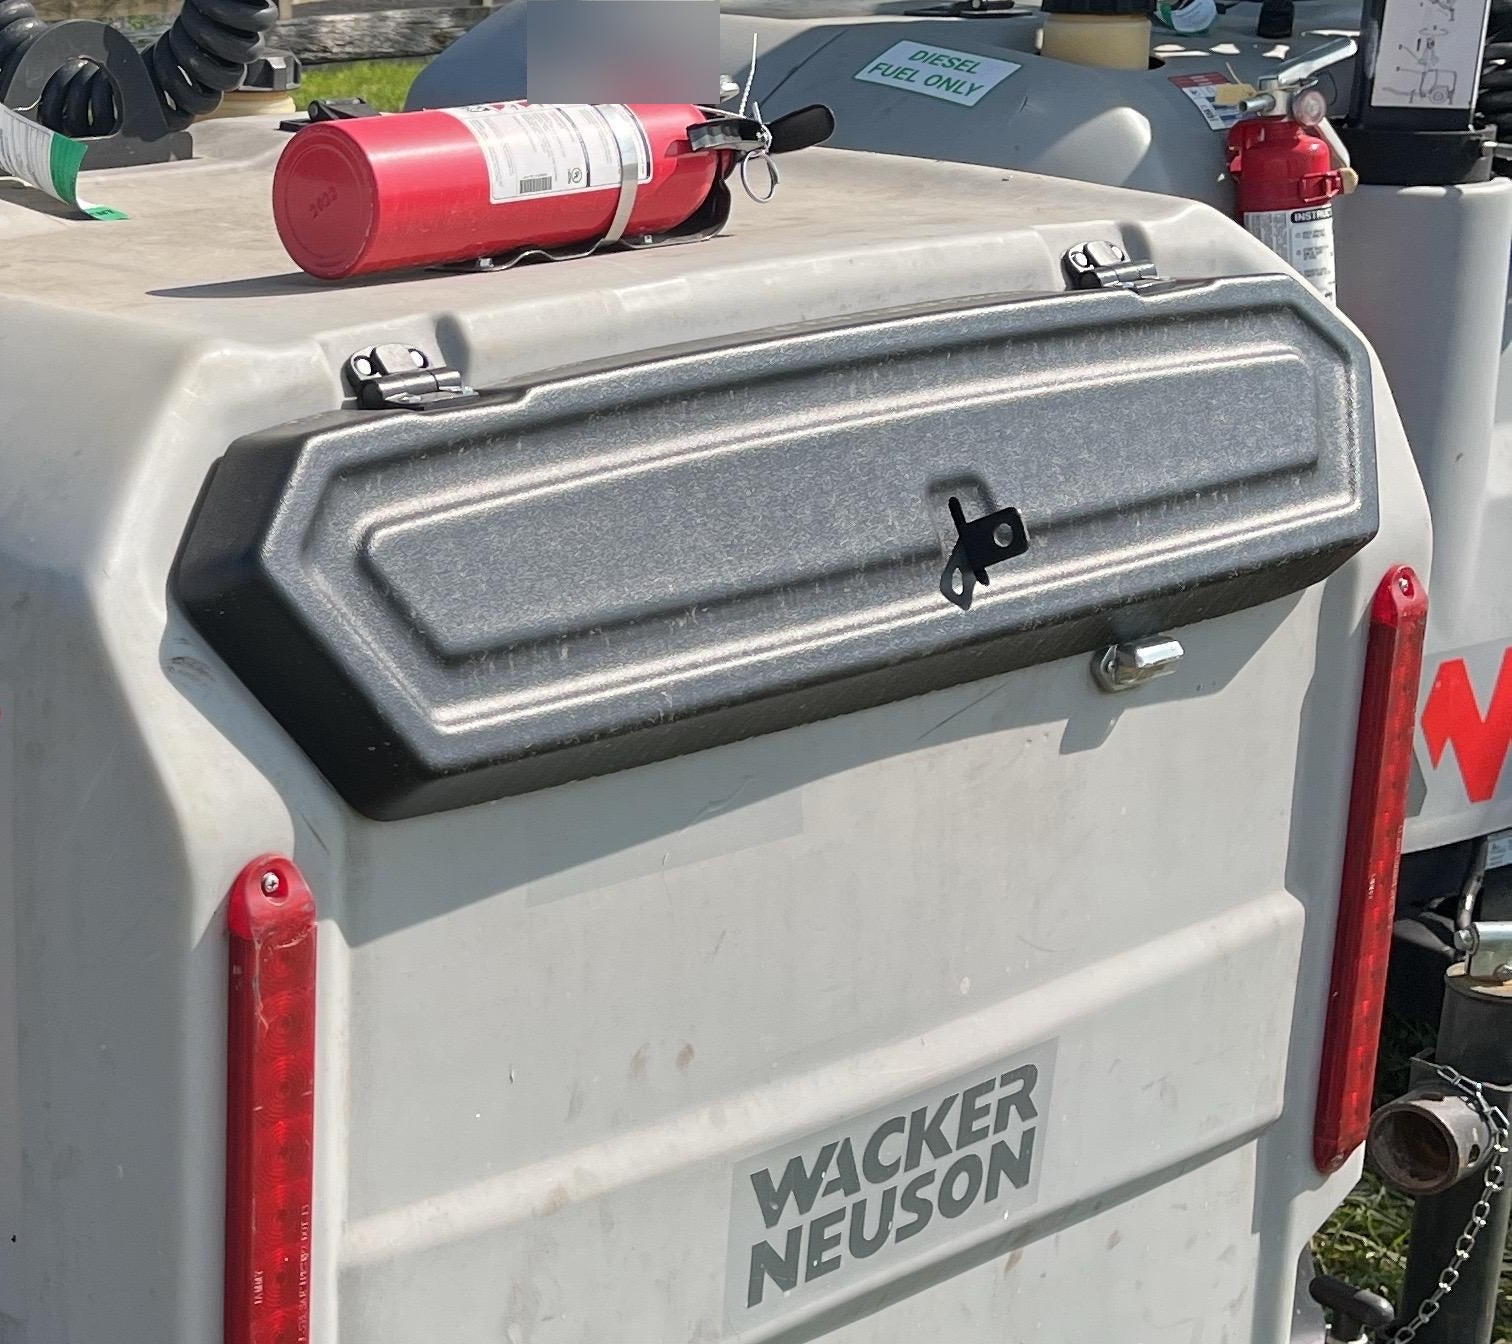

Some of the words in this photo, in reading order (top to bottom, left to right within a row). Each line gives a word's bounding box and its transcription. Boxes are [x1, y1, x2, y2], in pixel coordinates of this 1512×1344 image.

[867, 61, 921, 83] FUEL
[923, 73, 985, 97] ONLY
[908, 49, 983, 75] DIESEL
[749, 1063, 1039, 1230] WACKER
[746, 1125, 1037, 1309] NEUSON
